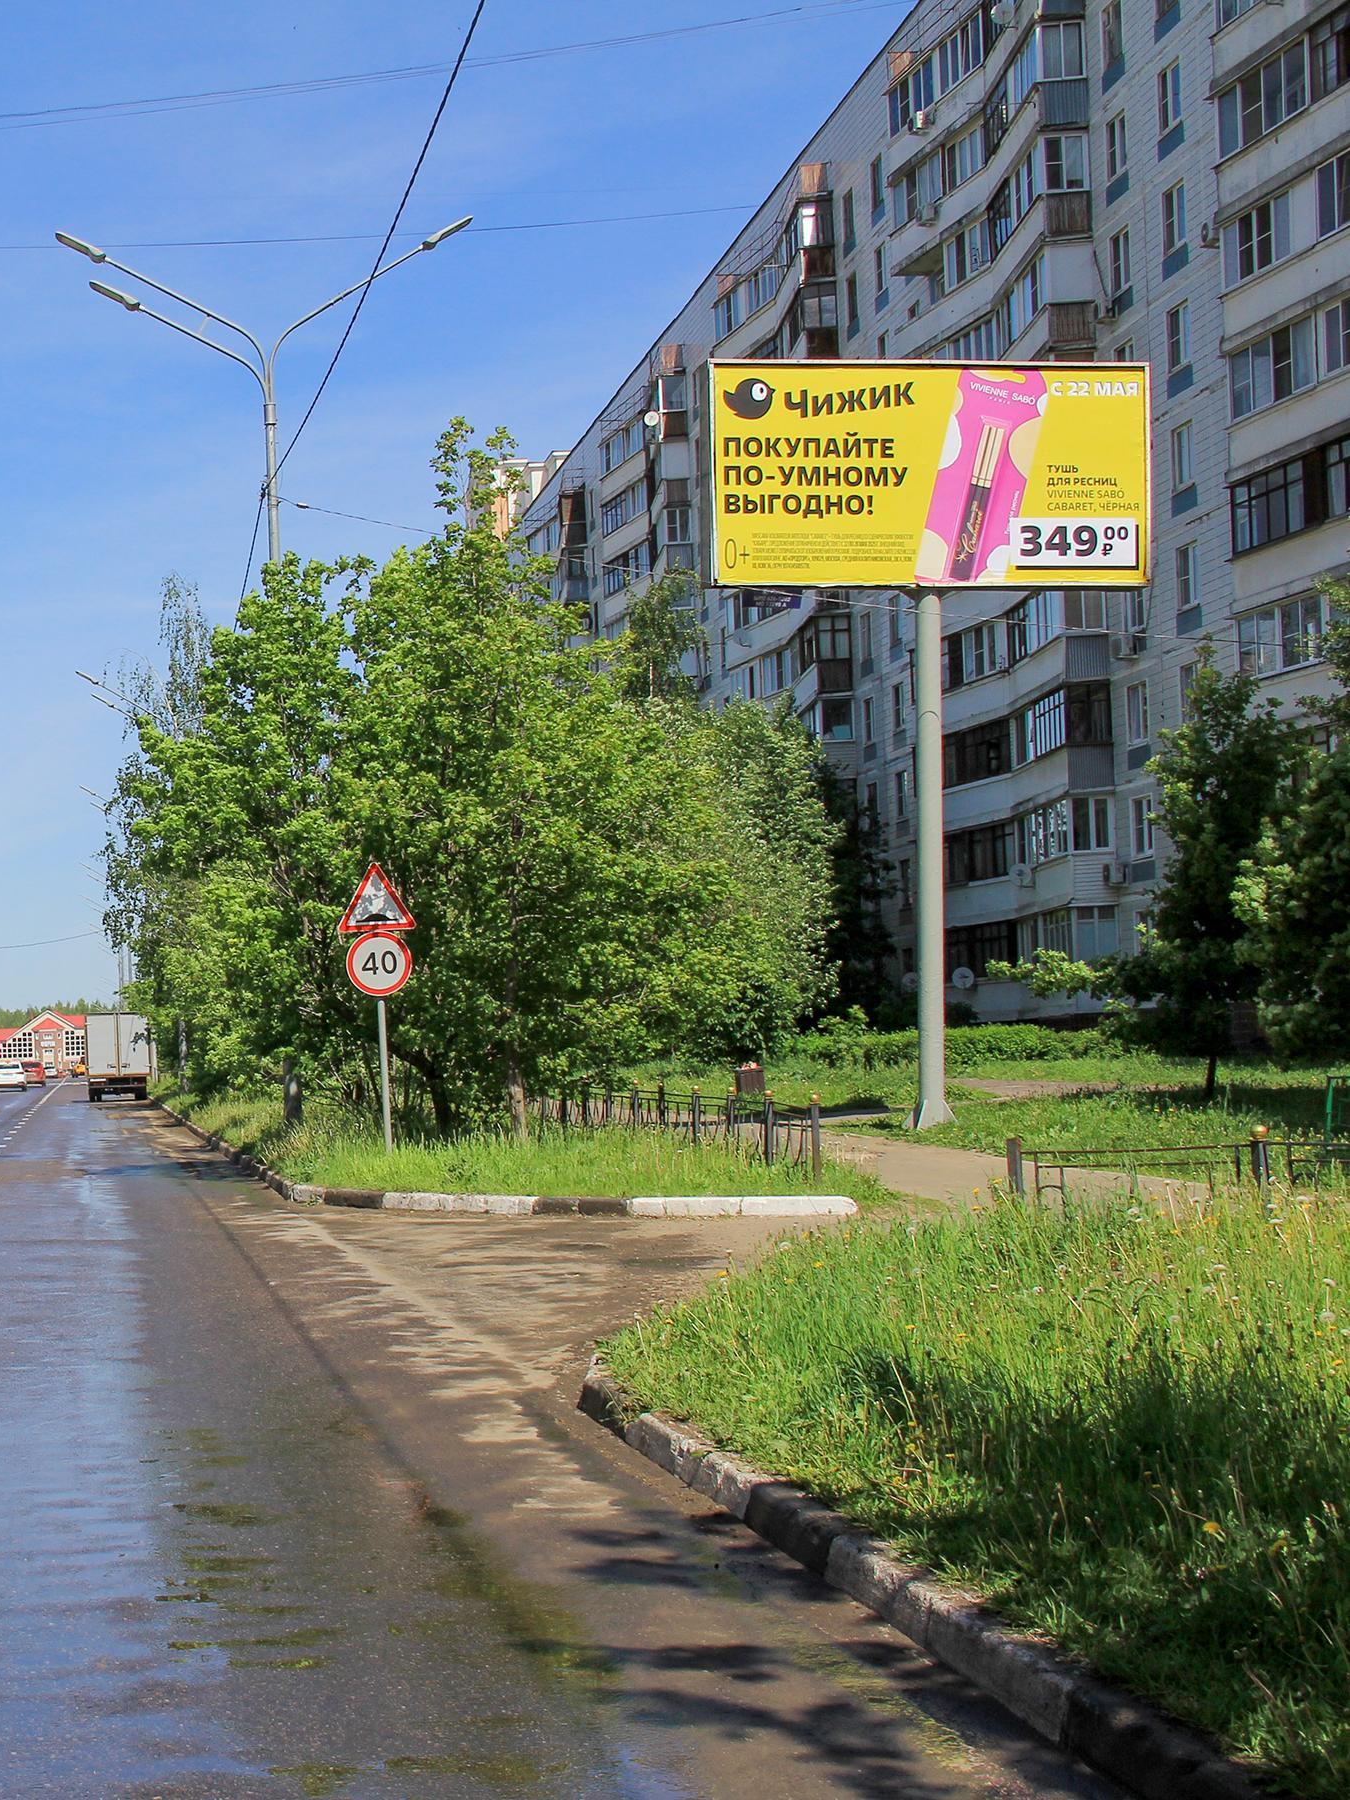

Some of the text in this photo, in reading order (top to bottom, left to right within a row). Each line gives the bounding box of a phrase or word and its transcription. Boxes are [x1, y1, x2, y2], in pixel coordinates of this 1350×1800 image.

[970, 381, 1009, 399] VIVIENNE
[1050, 381, 1139, 397] С 22 МАЯ
[723, 432, 895, 459] ПОКУПАЙТЕ
[723, 465, 908, 487] ПО-УМНОМУ
[1046, 464, 1079, 473] ТУШЬ
[1046, 477, 1118, 487] ДЛЯ РЕСНИЦ
[1046, 490, 1095, 499] VIVIENNE
[724, 494, 874, 519] ВЫГОДНО!
[1046, 501, 1140, 512] CABARET, ЧЁРНАЯ
[1019, 525, 1129, 557] 349 00
[724, 538, 750, 569] 0+
[361, 950, 397, 976] 40
